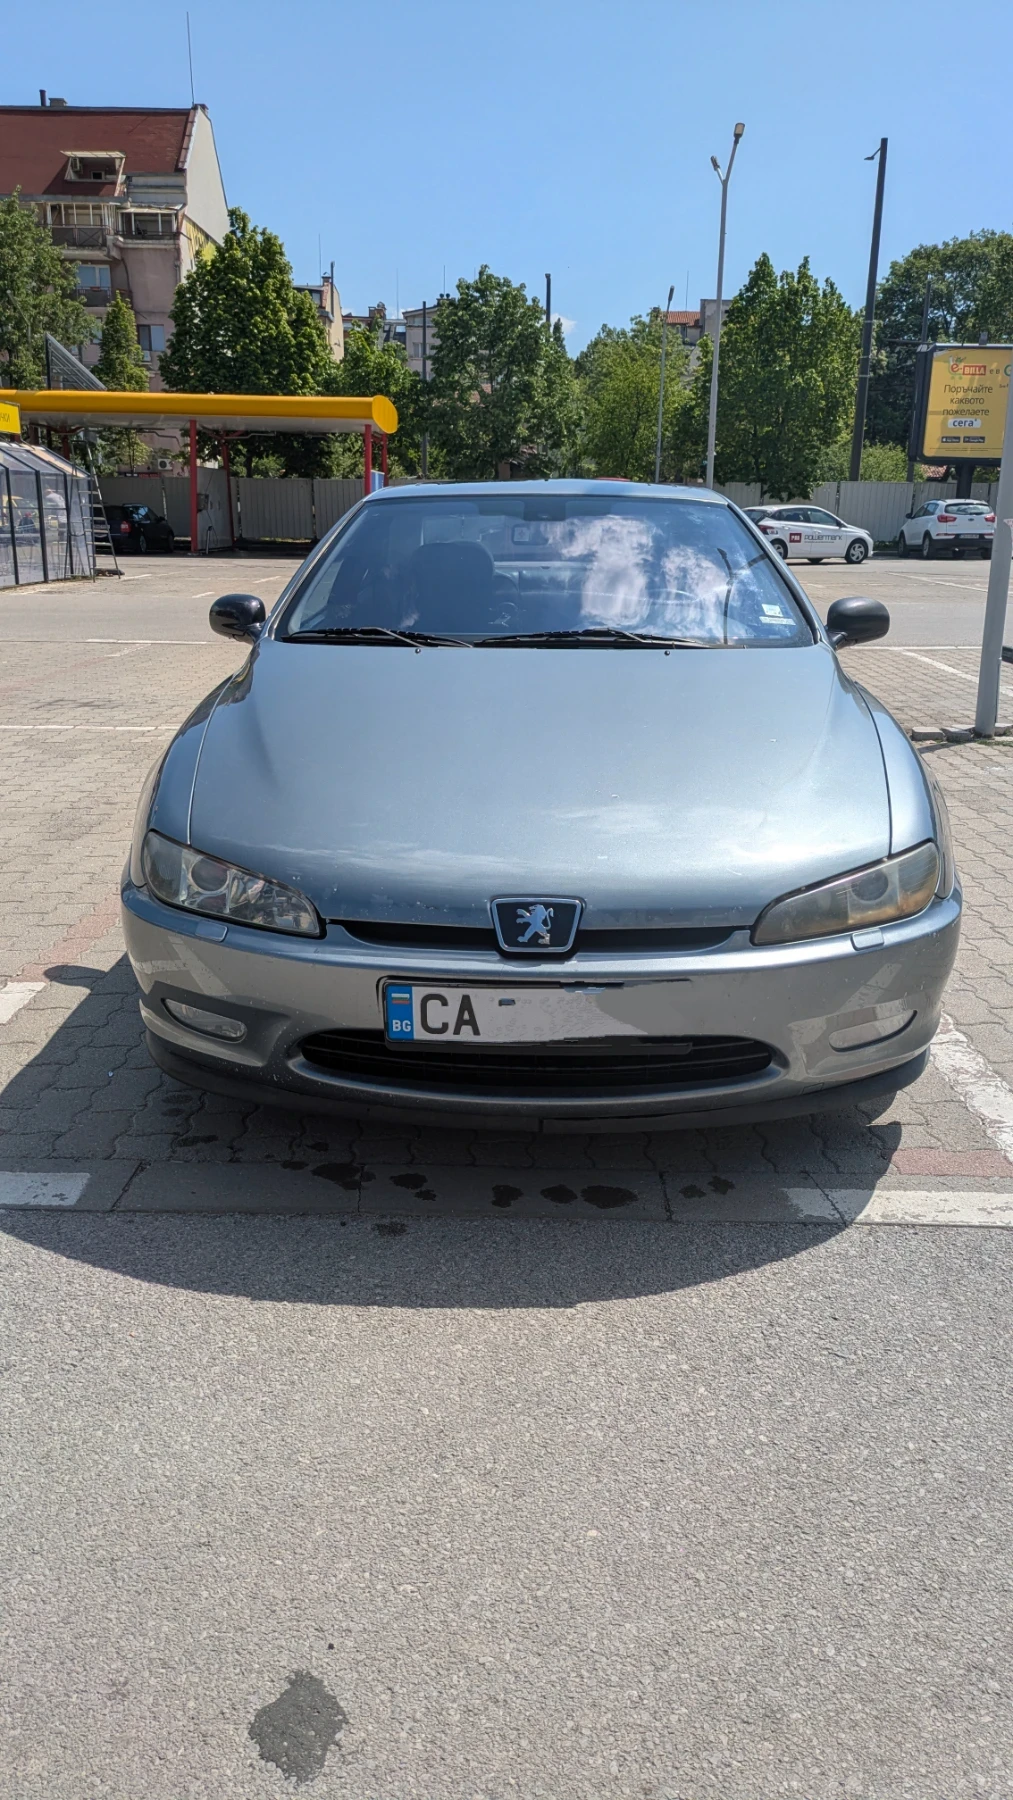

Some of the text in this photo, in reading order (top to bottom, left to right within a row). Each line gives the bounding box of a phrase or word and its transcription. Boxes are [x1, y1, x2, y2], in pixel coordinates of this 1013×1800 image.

[944, 385, 993, 395] Поръчайте
[392, 992, 481, 1036] BG CA
